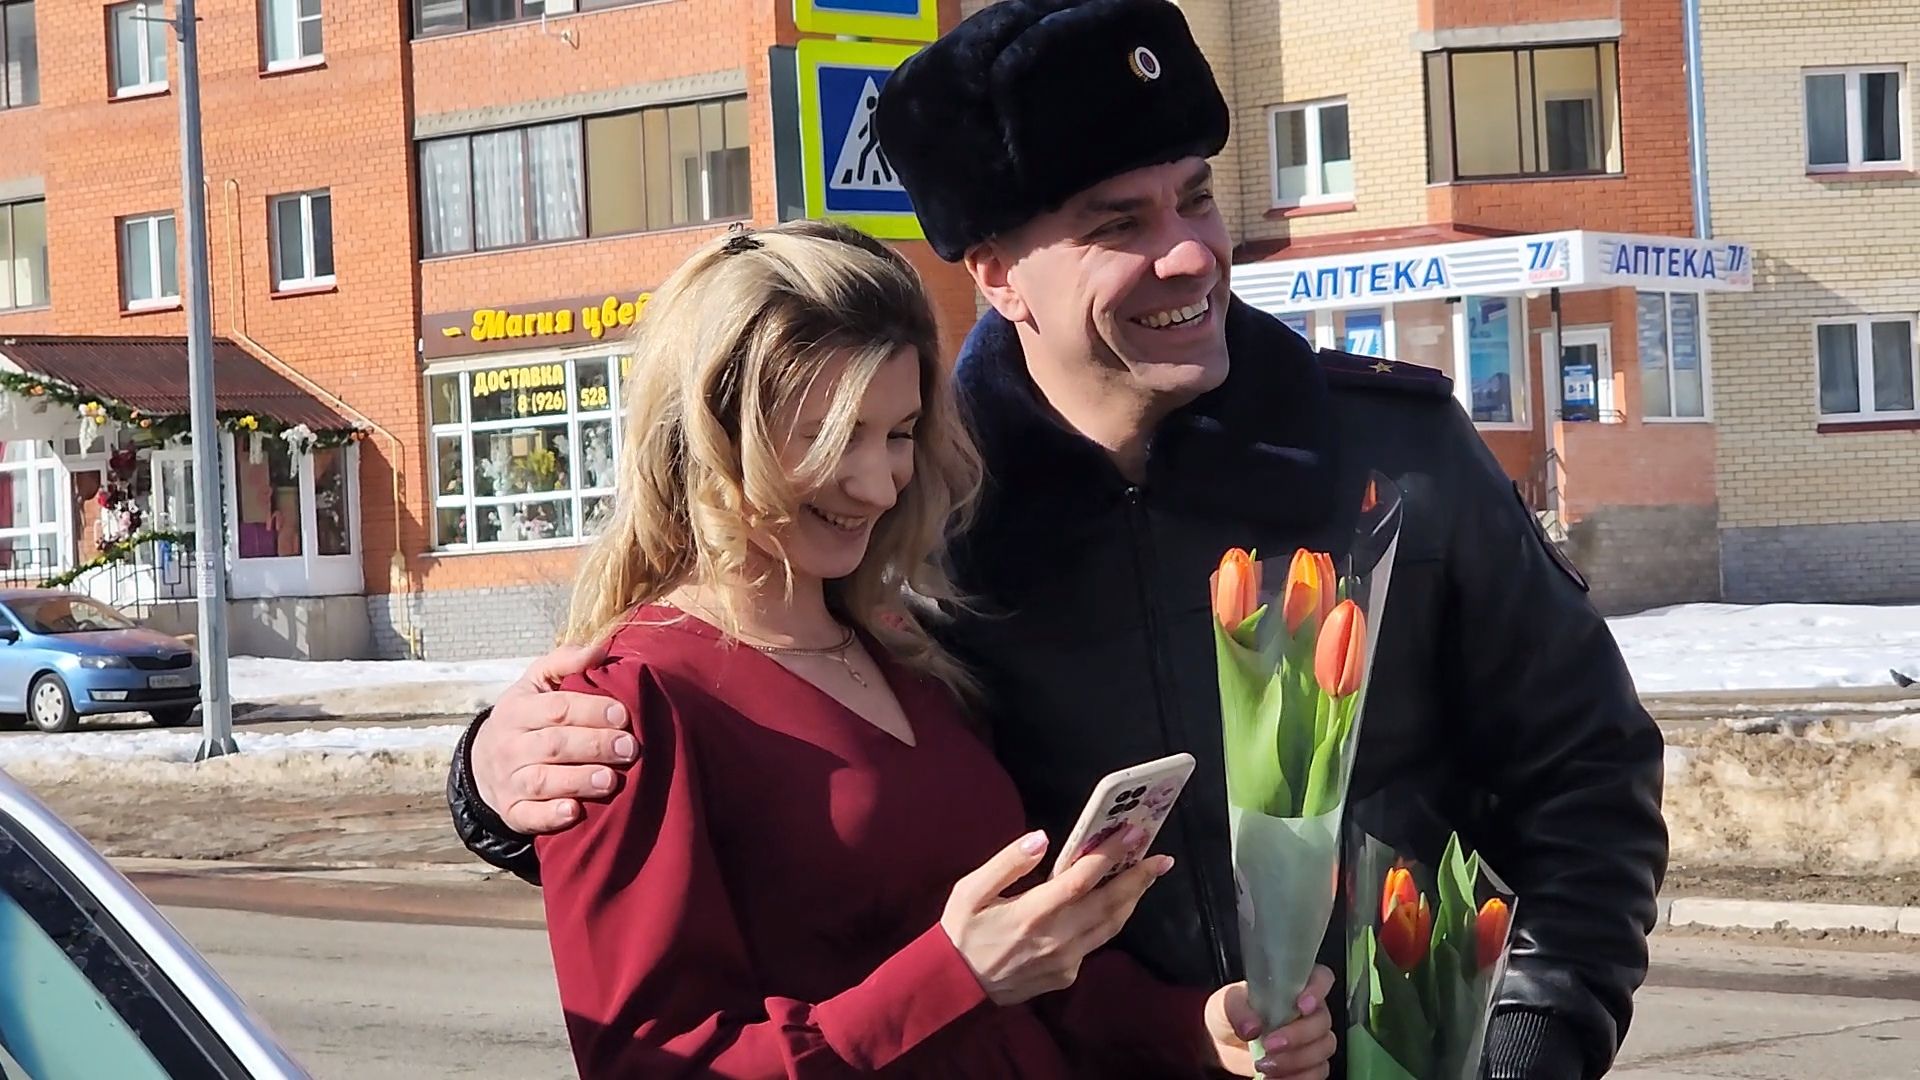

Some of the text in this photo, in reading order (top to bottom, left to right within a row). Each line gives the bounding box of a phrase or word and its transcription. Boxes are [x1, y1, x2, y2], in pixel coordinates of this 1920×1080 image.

[1290, 257, 1446, 300] АПТЕКА
[1615, 244, 1716, 279] АПТЕКА
[470, 308, 574, 342] Магия
[473, 363, 564, 397] ДОСТАВКА
[517, 386, 608, 414] 8 (926) 528
